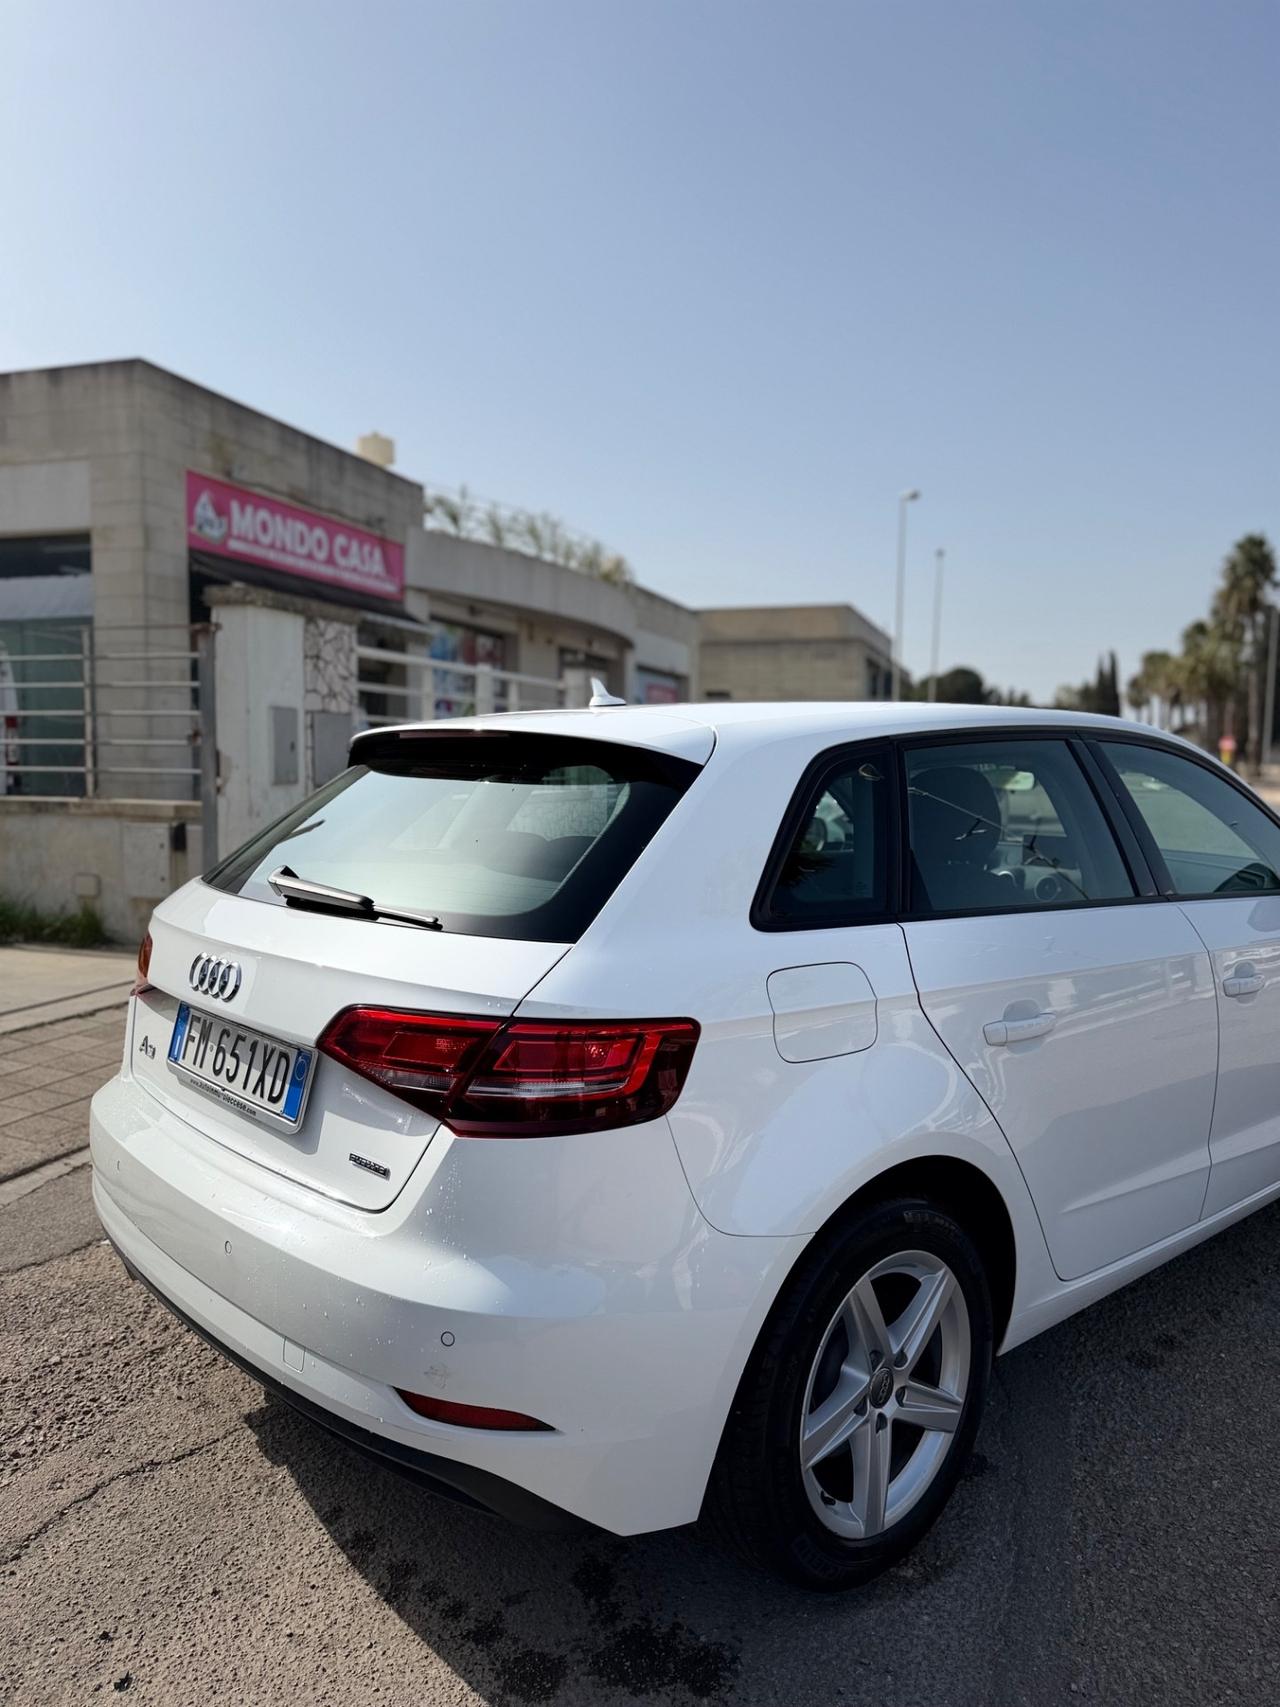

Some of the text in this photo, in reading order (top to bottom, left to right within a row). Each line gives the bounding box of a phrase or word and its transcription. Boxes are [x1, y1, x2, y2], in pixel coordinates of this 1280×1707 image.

[229, 498, 329, 562] MONDO
[333, 534, 387, 576] CASA
[139, 1035, 156, 1060] A3
[182, 1014, 291, 1104] FM 651XD
